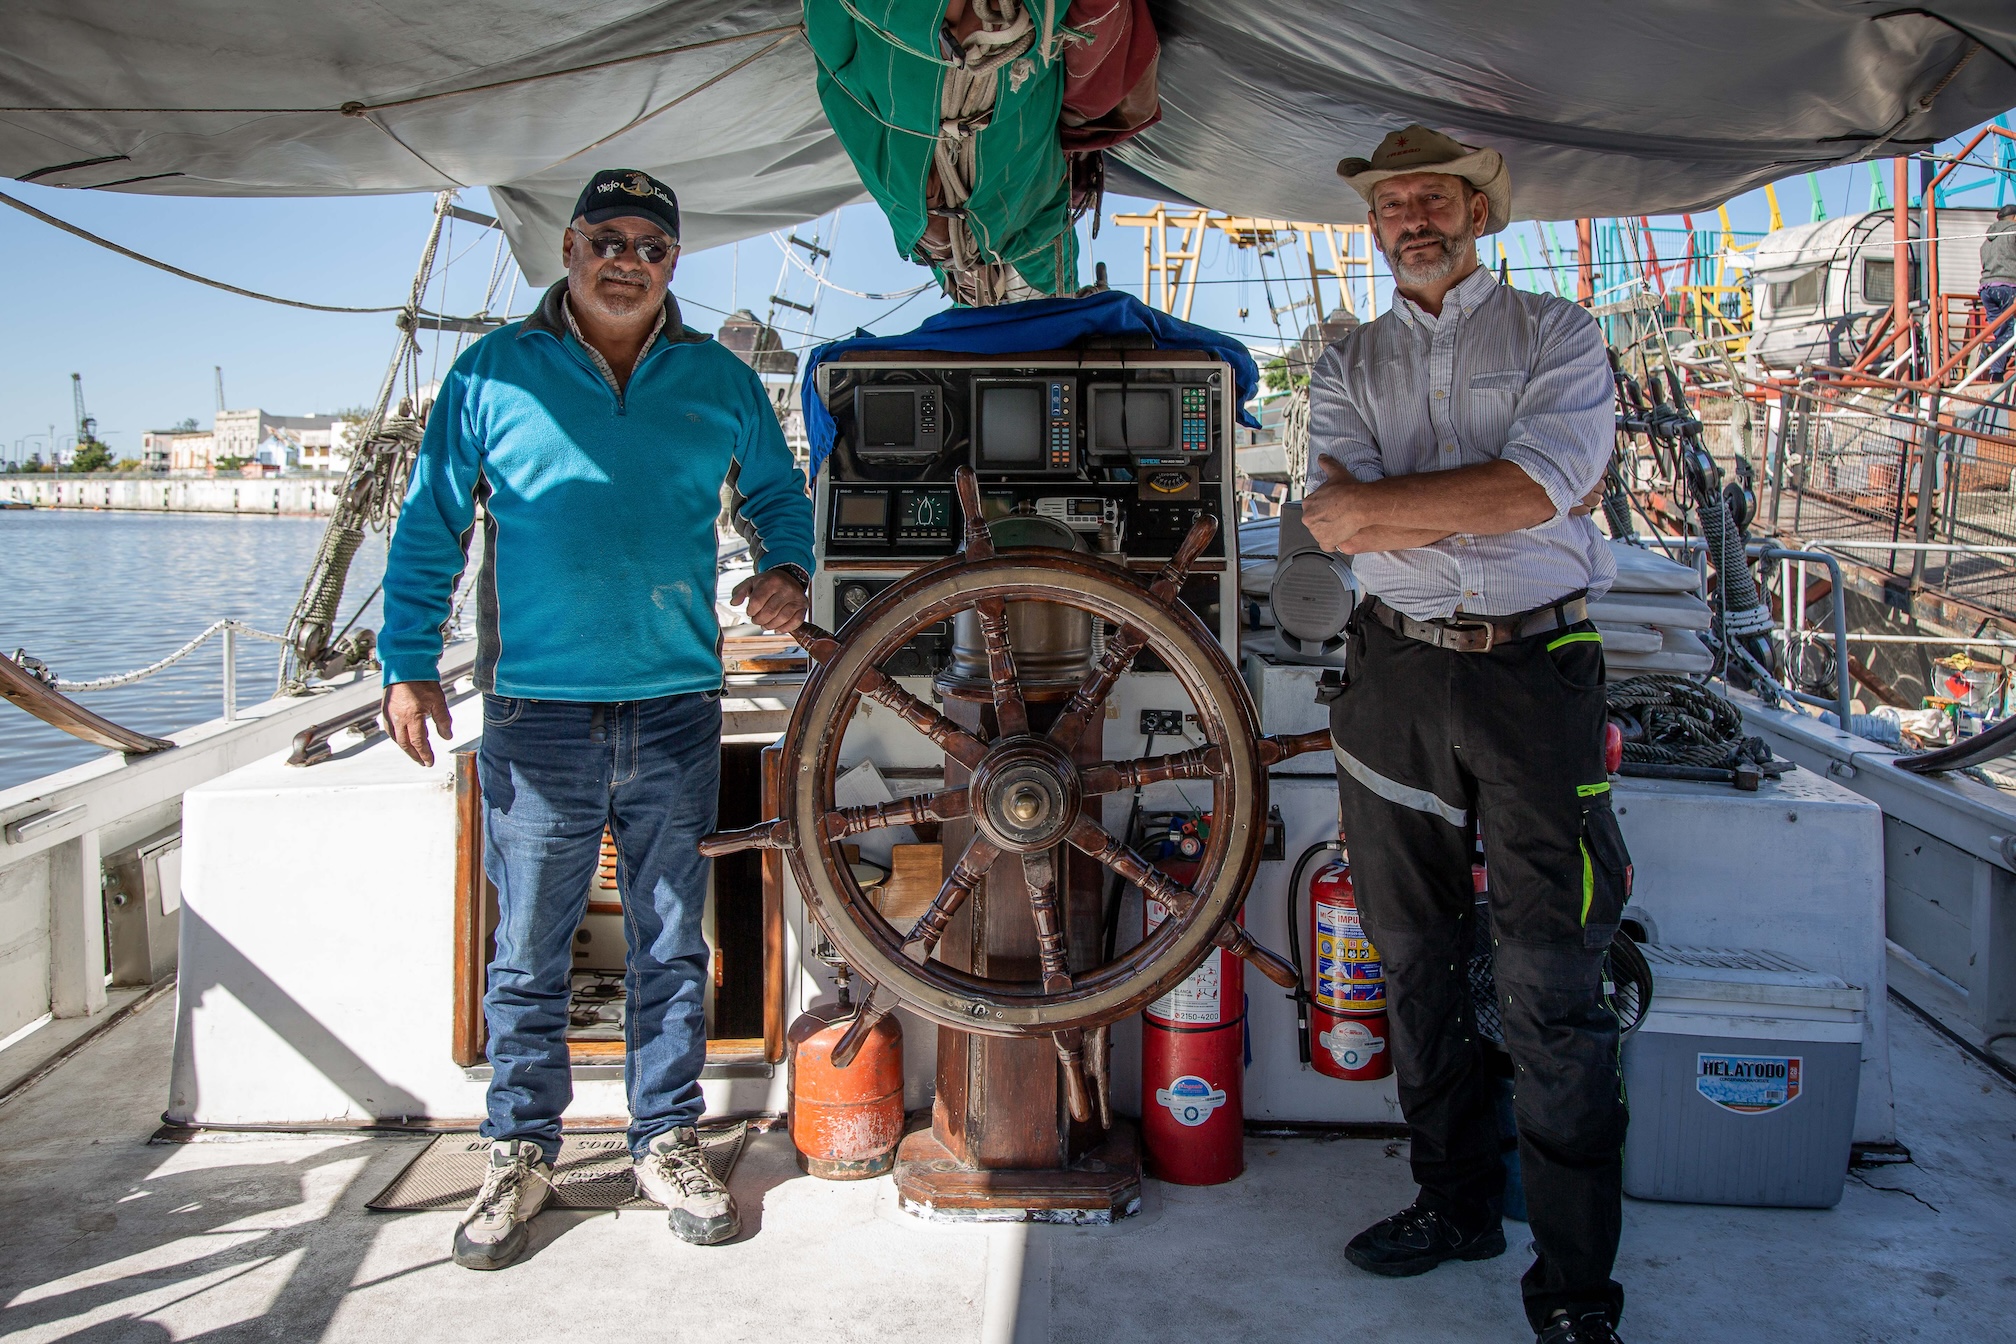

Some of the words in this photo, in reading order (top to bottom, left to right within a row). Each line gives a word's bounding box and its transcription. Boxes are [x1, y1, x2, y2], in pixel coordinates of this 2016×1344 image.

[596, 180, 620, 194] Viejo
[1318, 865, 1353, 885] 2
[1180, 1012, 1219, 1021] 2150-4200
[1703, 1059, 1785, 1078] HELATODO
